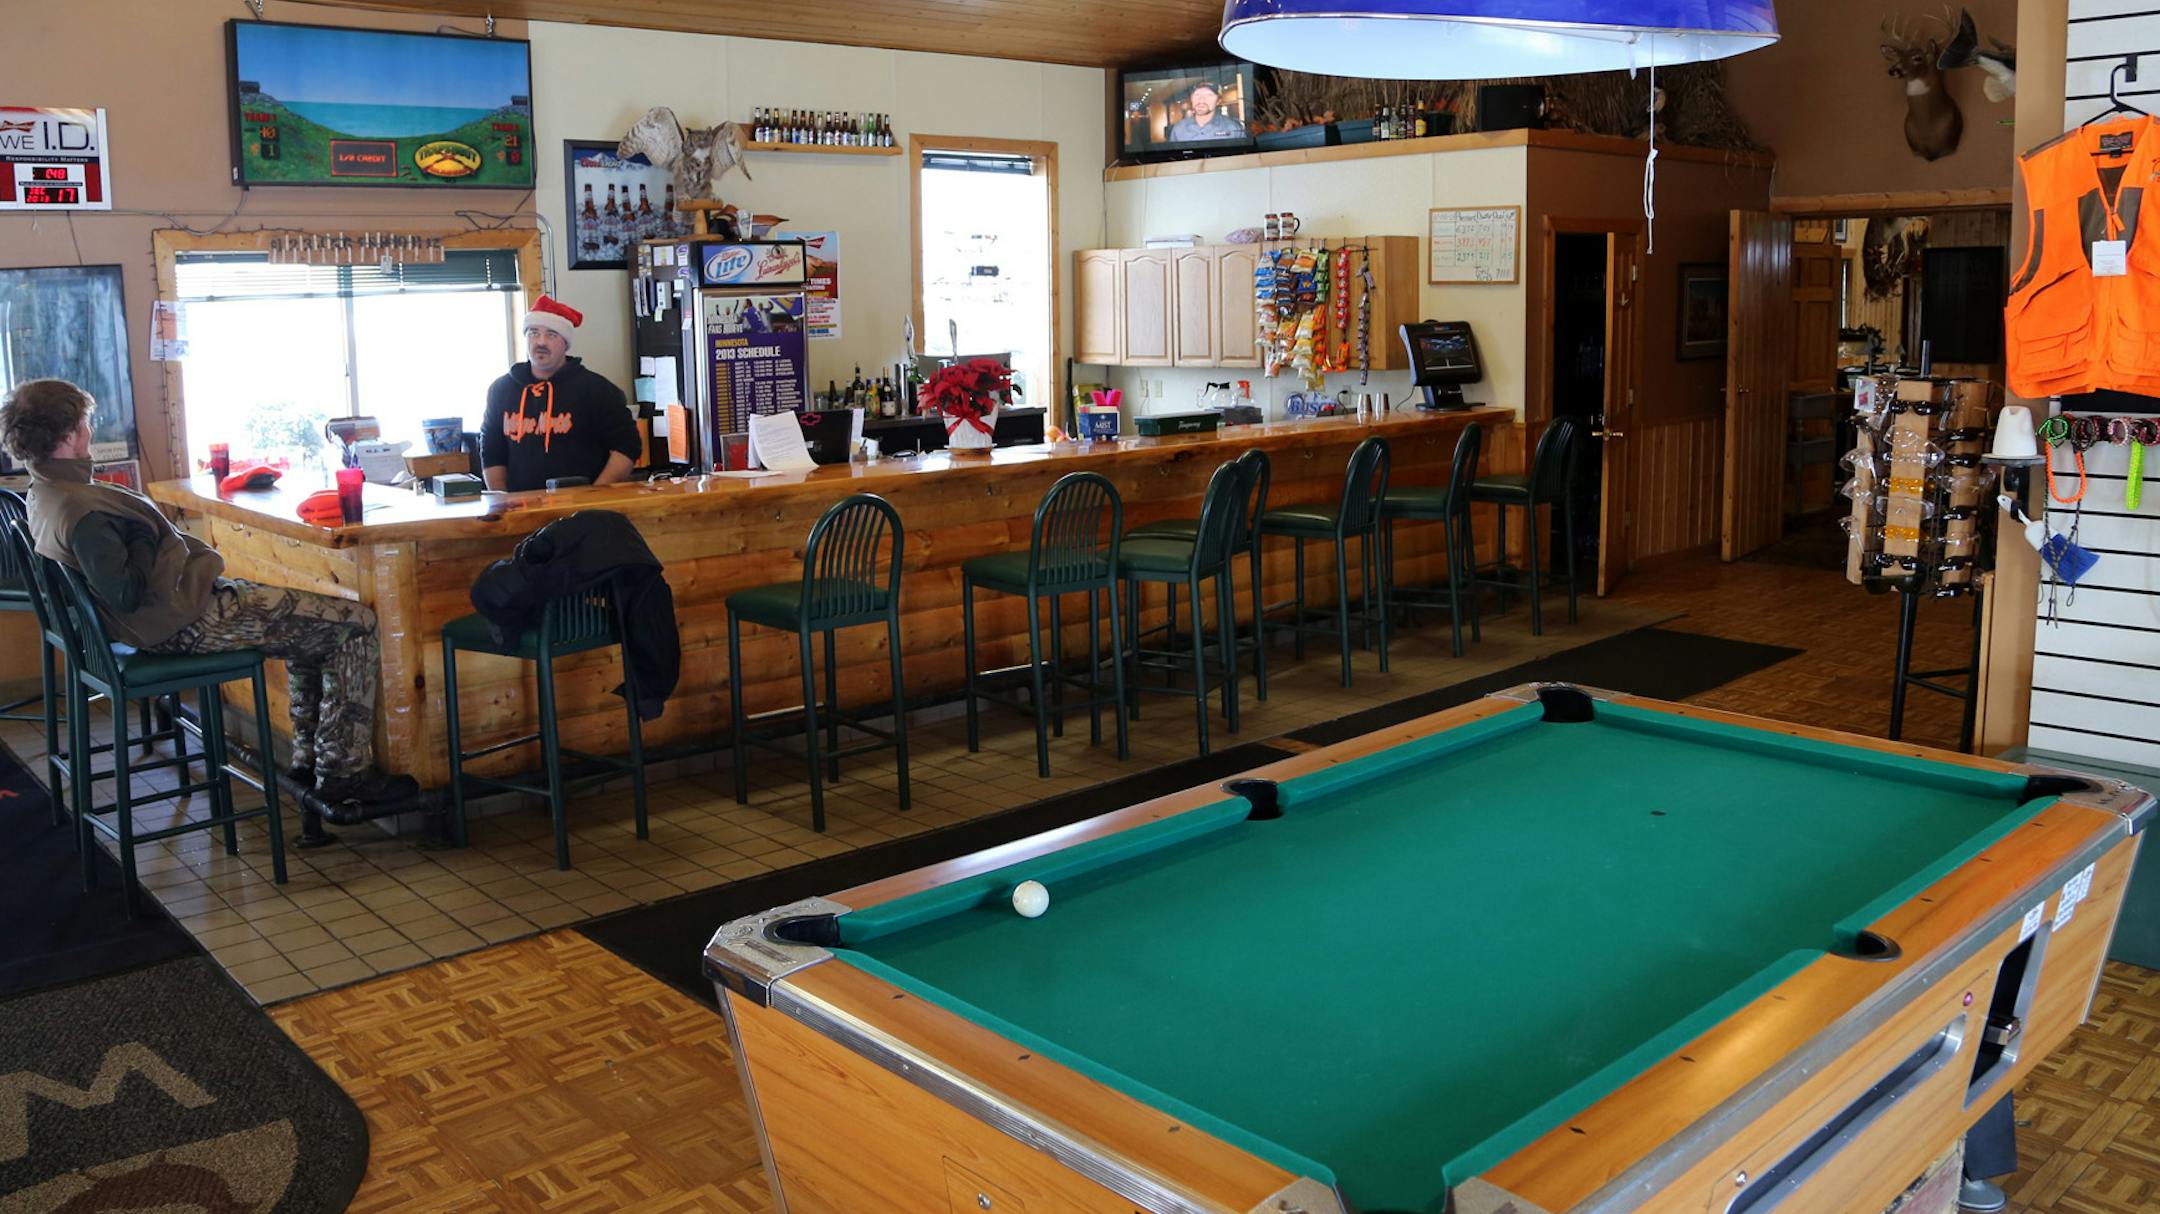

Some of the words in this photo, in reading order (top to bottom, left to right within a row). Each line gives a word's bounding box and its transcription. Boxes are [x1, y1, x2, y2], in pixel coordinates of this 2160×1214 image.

[43, 121, 95, 151] I.D.
[715, 254, 747, 278] Lite
[715, 348, 736, 360] 2013
[737, 346, 781, 359] SCHEDULE
